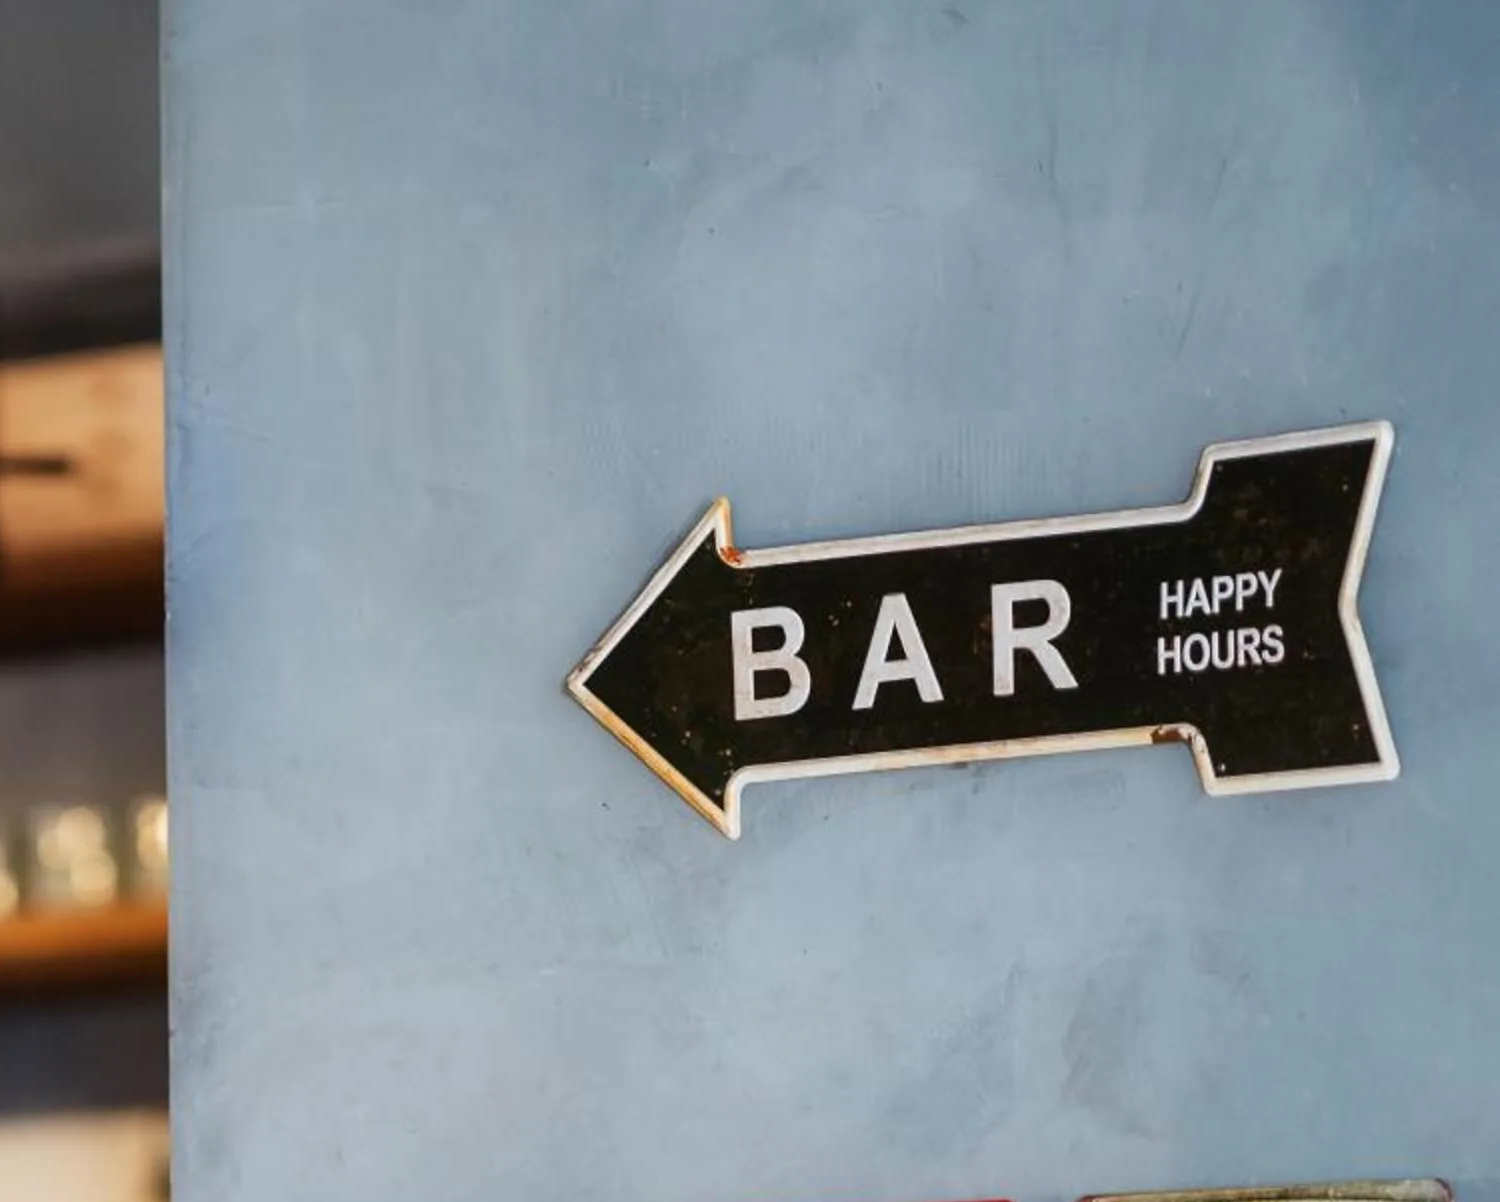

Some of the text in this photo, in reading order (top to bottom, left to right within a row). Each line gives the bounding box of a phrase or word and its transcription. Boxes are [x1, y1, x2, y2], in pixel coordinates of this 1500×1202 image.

[1160, 568, 1282, 620] HAPPY
[730, 578, 1079, 722] BAR
[1157, 624, 1285, 676] HOURS
